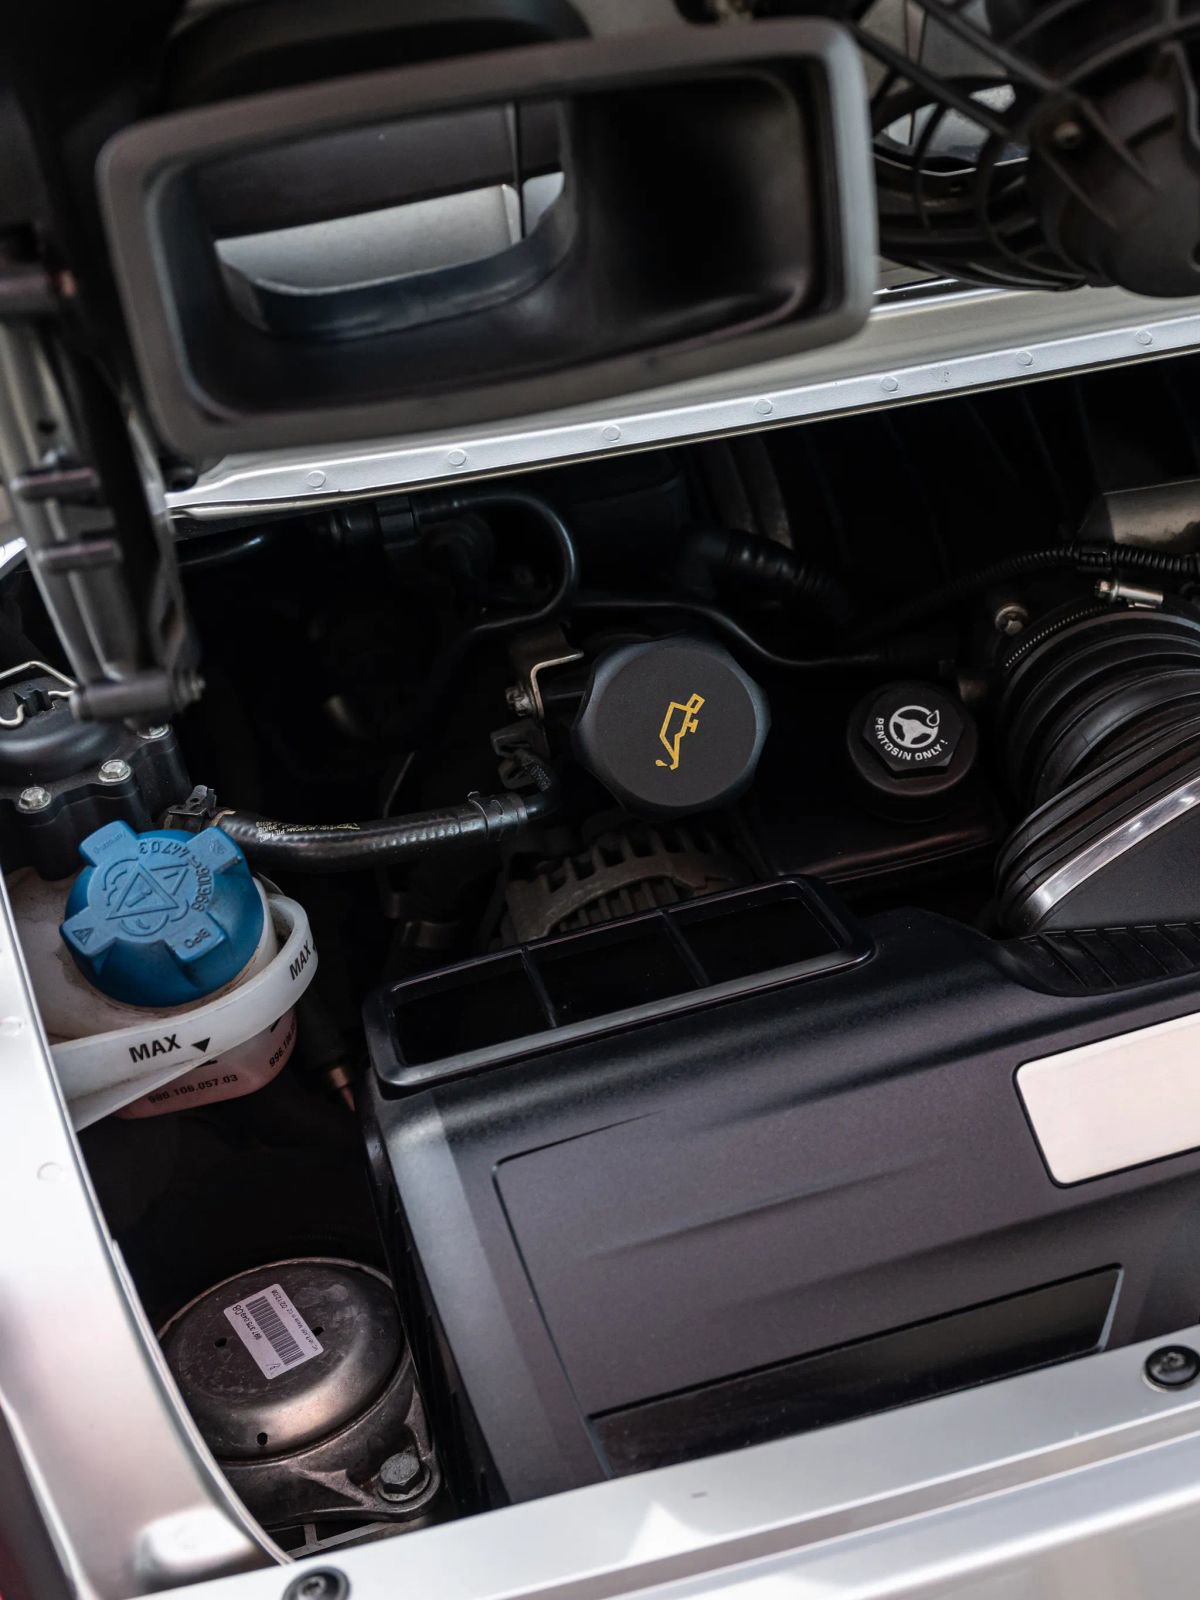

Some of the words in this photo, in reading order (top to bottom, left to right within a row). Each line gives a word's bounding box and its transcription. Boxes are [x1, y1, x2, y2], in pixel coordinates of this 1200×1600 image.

[875, 717, 912, 760] PENTOSIN
[289, 940, 311, 980] MAX
[129, 1033, 182, 1063] MAX
